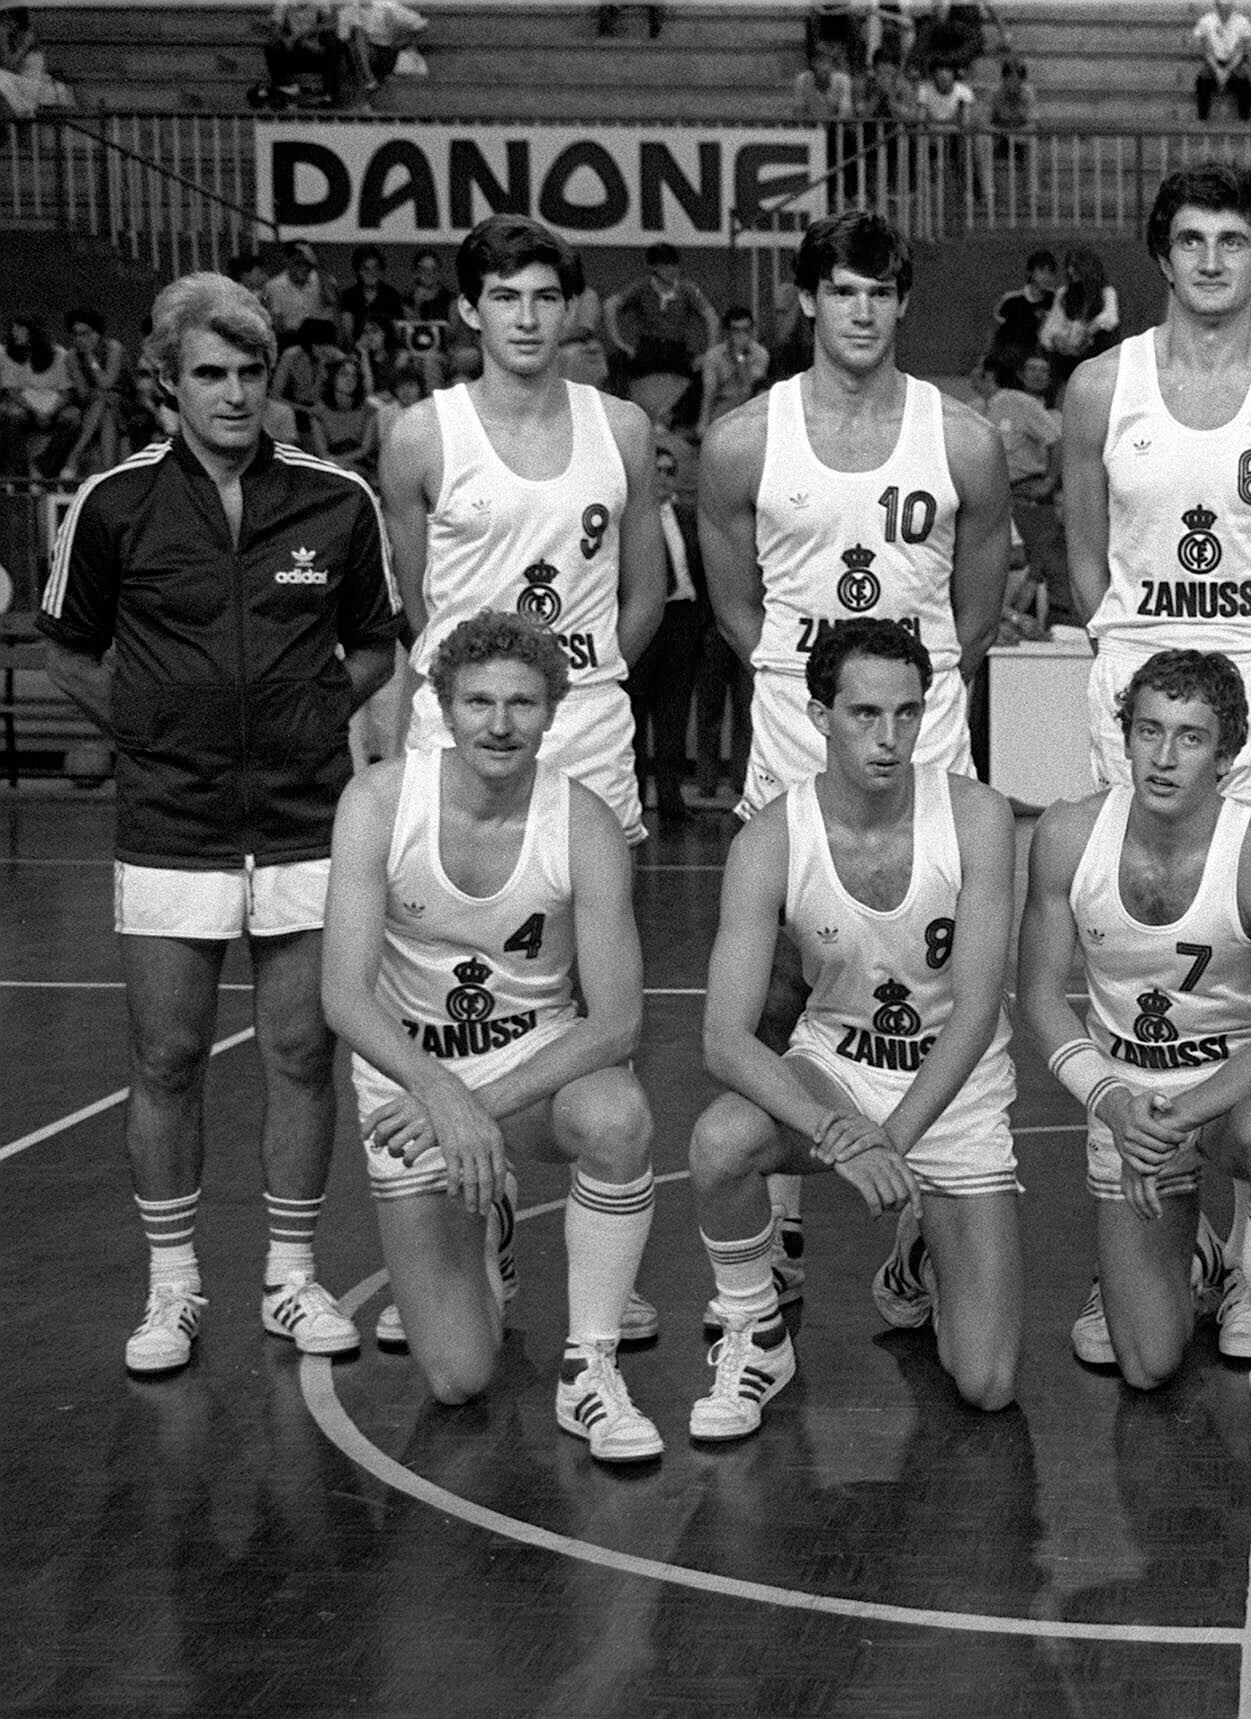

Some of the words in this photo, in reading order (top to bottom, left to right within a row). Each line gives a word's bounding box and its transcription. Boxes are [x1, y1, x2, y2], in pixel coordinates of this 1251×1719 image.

[272, 138, 811, 231] DANONE
[580, 503, 609, 560] 9
[878, 486, 937, 544] 10
[275, 568, 329, 585] adidas
[503, 913, 546, 959] 4
[925, 917, 955, 969] 8
[1176, 942, 1213, 992] 7
[836, 1023, 937, 1072] ZANUS
